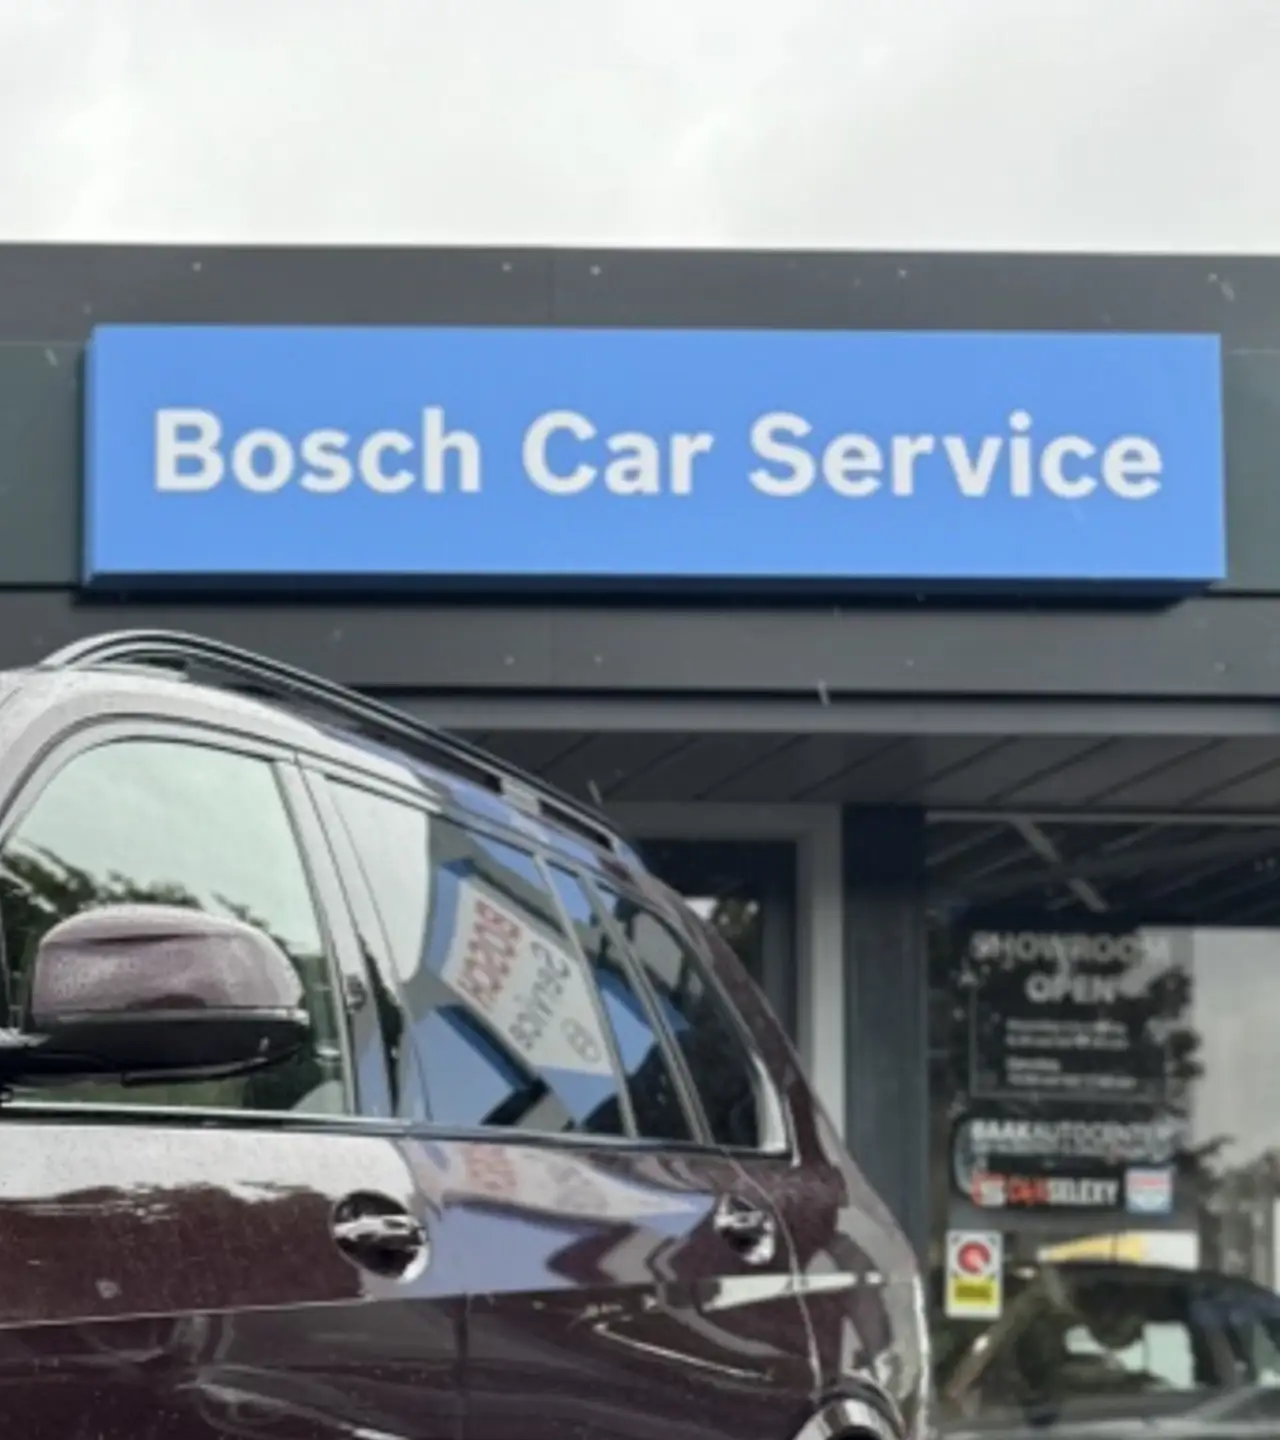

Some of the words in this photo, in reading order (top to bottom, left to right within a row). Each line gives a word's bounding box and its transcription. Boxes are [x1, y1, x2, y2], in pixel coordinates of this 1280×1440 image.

[157, 408, 479, 492] Bosch
[524, 412, 713, 493] Car
[751, 412, 1161, 498] Service
